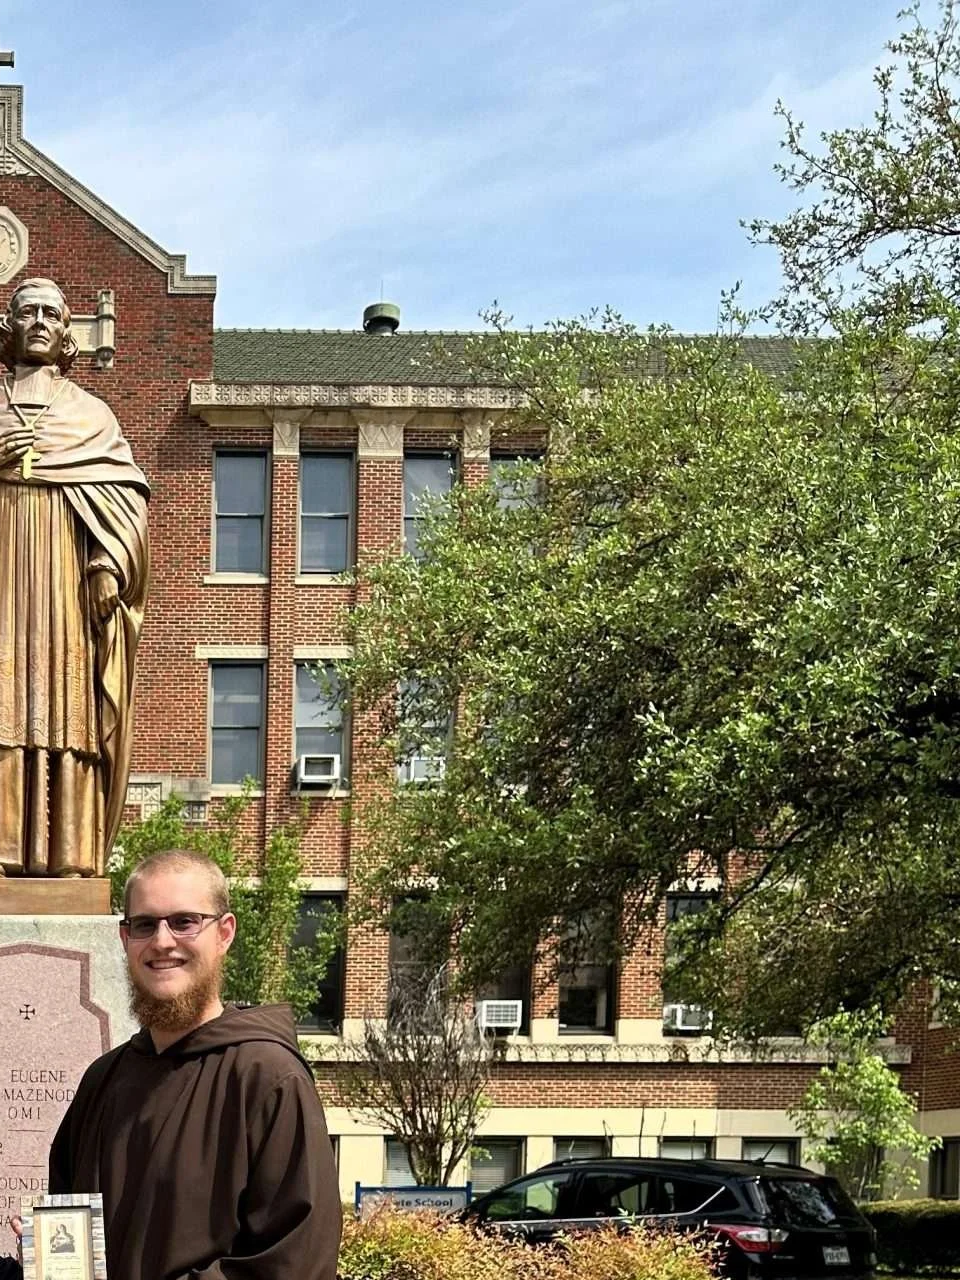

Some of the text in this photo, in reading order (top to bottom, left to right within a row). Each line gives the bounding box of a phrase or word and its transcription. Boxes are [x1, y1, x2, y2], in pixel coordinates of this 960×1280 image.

[11, 1069, 67, 1083] EUGENE
[3, 1088, 75, 1102] MAZENOD
[415, 1198, 452, 1208] School
